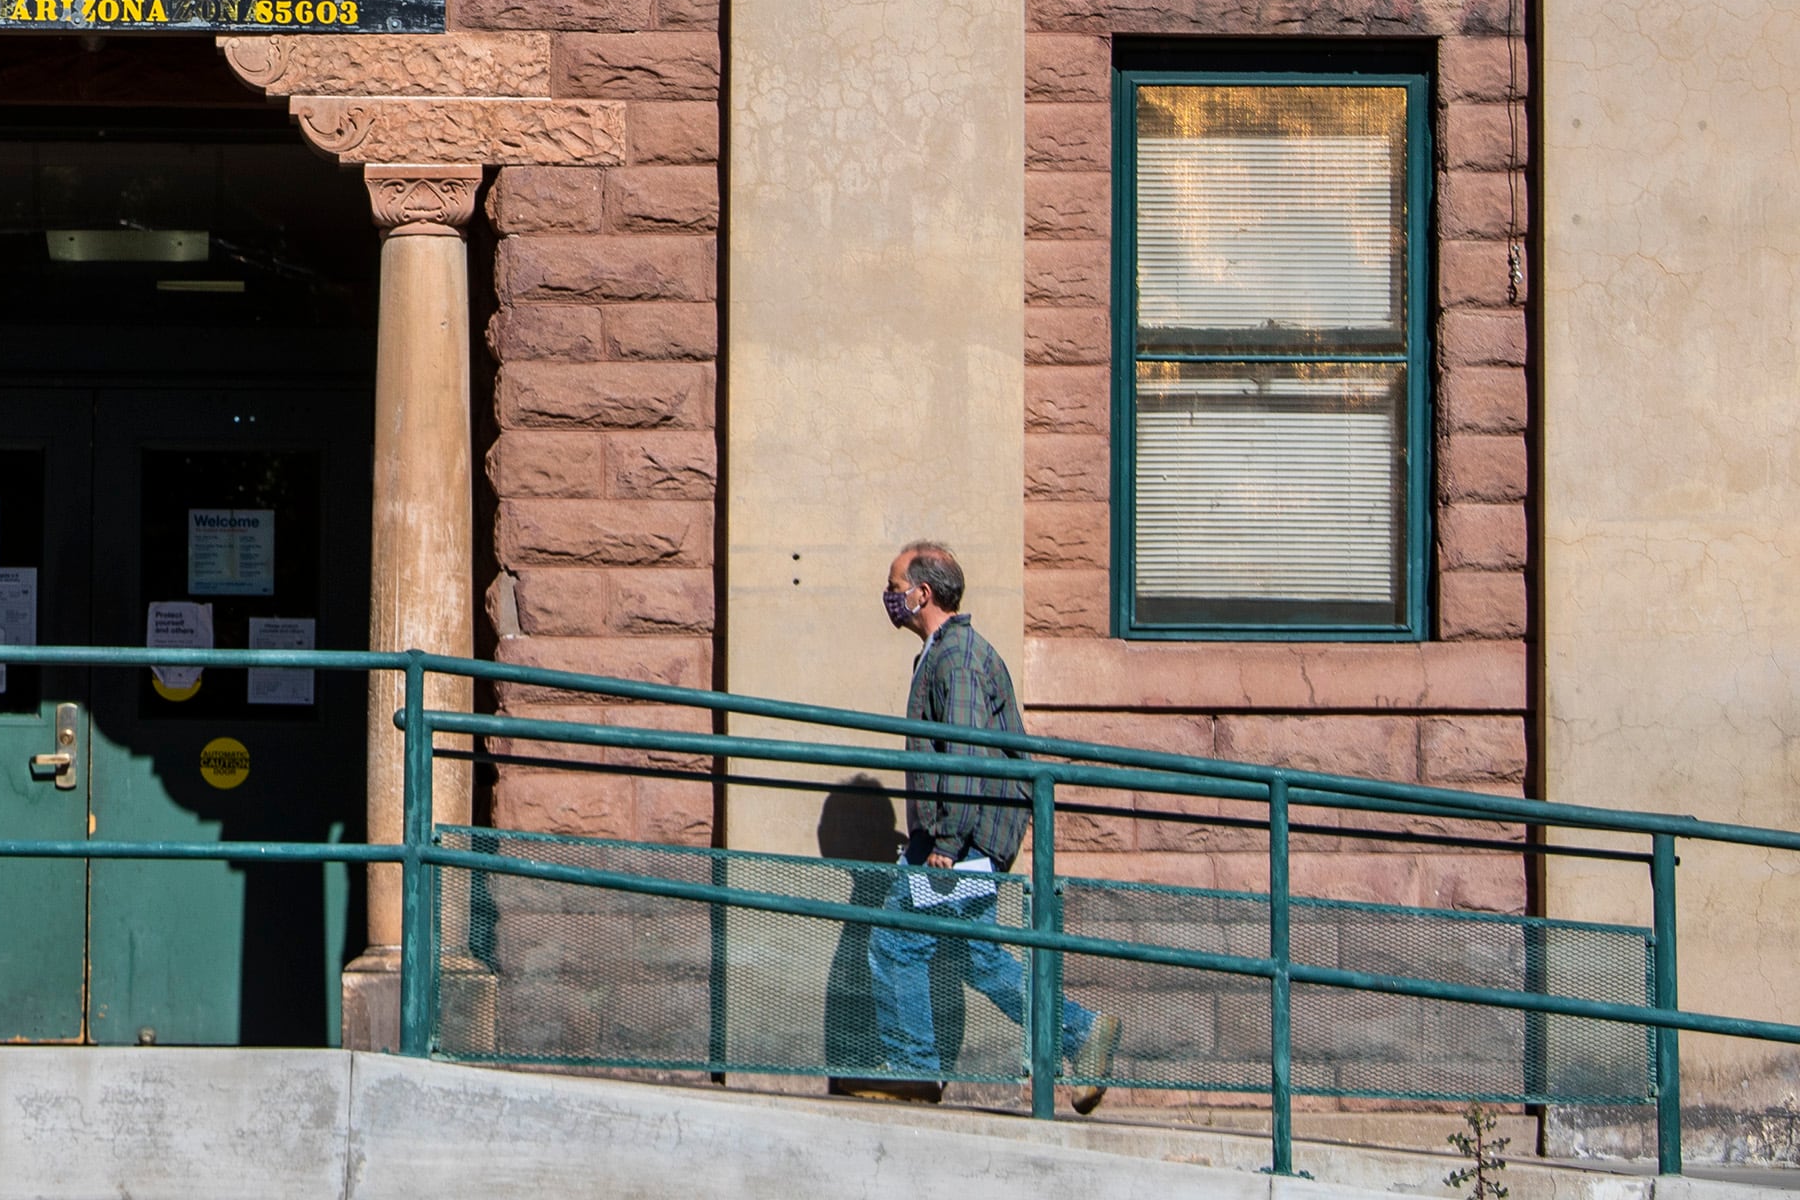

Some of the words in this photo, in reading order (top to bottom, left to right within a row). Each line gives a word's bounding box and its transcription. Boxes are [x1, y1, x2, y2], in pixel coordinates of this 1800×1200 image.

[256, 0, 359, 25] 85603
[194, 514, 260, 528] Welcome
[155, 619, 185, 627] yourself
[171, 627, 194, 635] others
[200, 758, 249, 769] CAUTION
